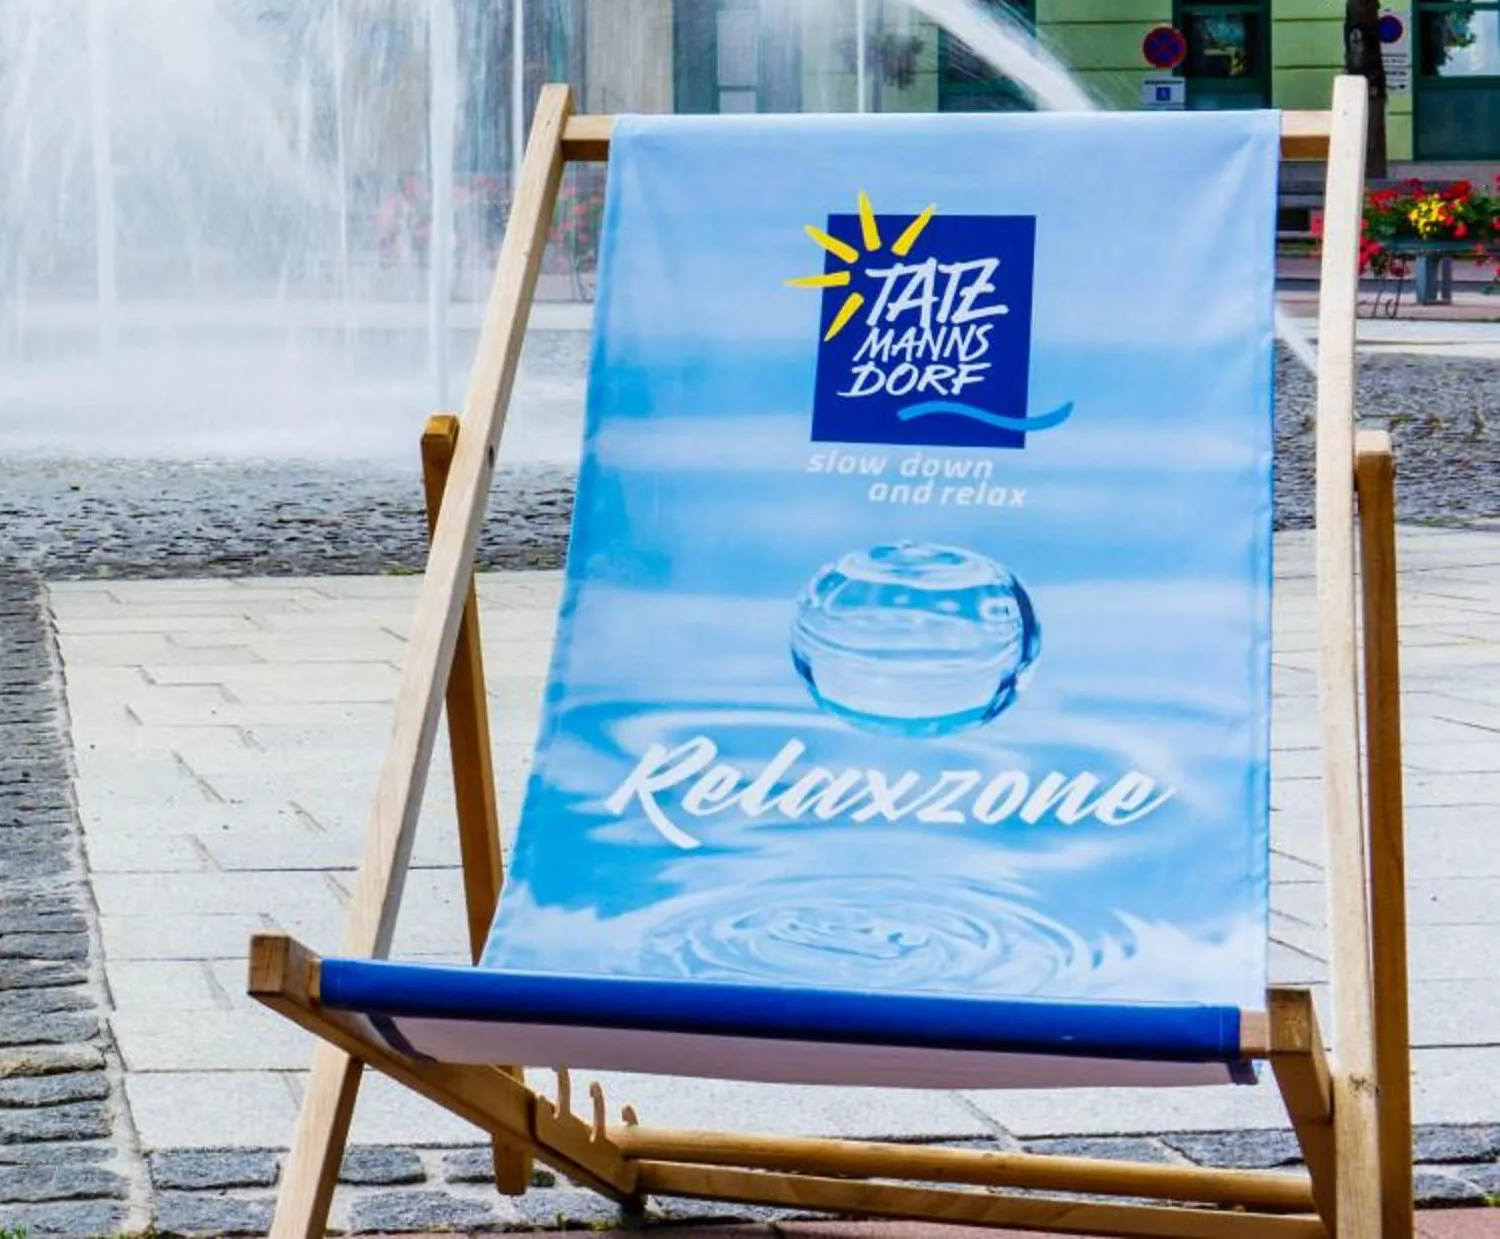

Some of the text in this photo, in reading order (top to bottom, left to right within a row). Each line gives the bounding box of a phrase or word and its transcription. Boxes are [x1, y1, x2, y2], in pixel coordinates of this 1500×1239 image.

[864, 257, 1009, 329] TATZ
[852, 323, 994, 362] MANNS
[836, 362, 992, 397] DORF
[805, 448, 994, 478] slow down
[868, 479, 1027, 508] and relax
[605, 737, 1176, 849] Relaxzone
